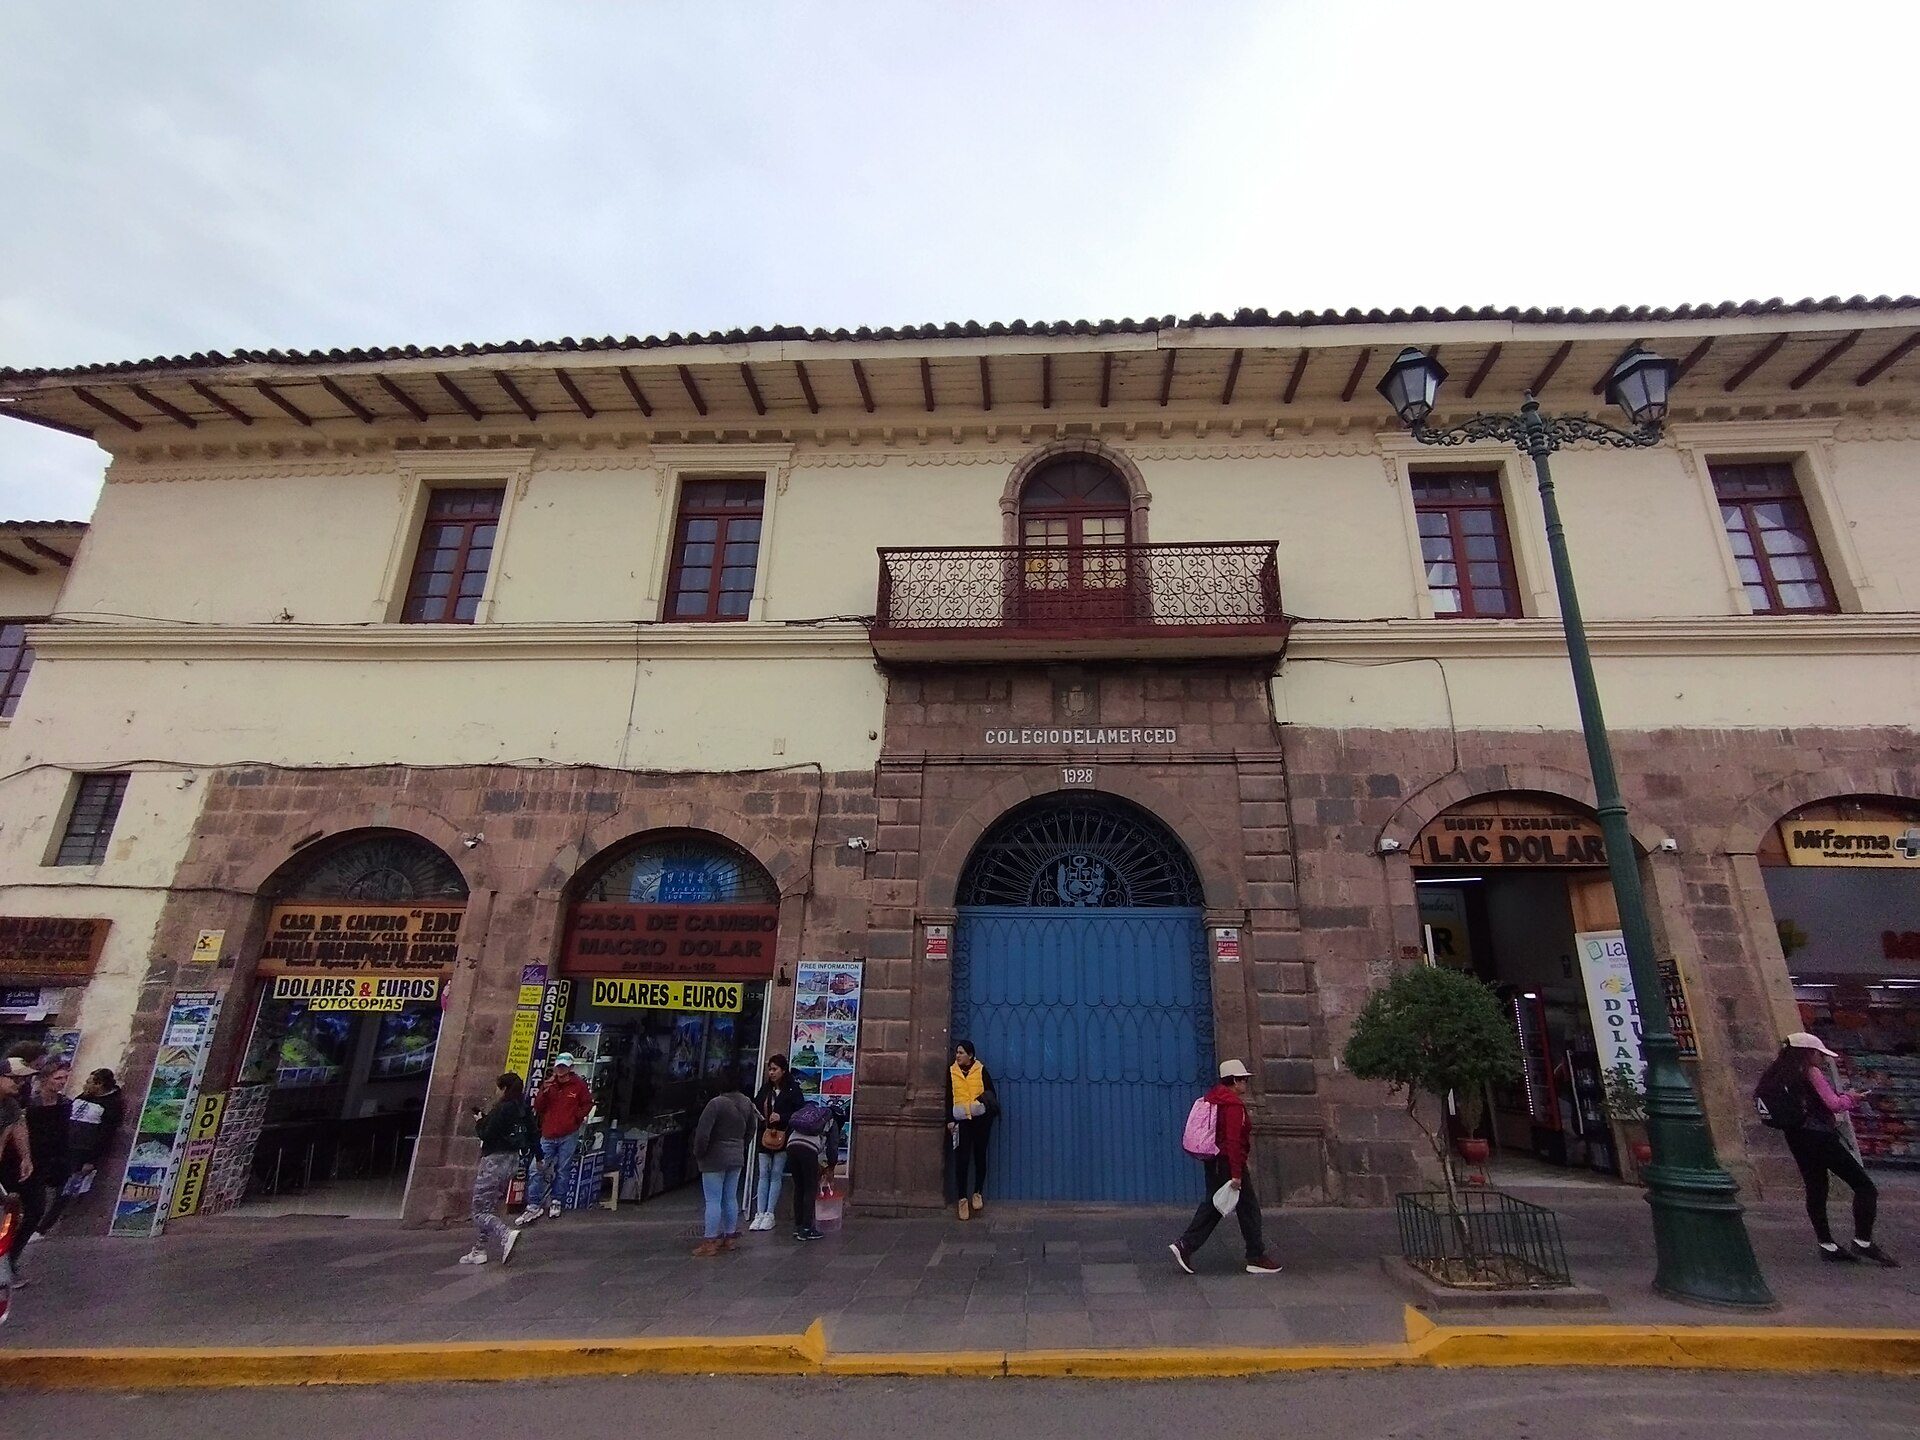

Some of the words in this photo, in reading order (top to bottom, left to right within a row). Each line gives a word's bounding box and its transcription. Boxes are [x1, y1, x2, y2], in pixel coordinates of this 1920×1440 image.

[1062, 768, 1093, 783] 1928
[1443, 818, 1494, 831] MONEY
[1502, 818, 1581, 831] EXCHANGE
[1793, 828, 1891, 850] Mifarma
[1427, 835, 1491, 862] LAC
[1500, 835, 1607, 863] DOLAR
[280, 913, 316, 931] CASA
[320, 915, 343, 931] DE
[346, 915, 408, 931] CAMBIO
[577, 913, 636, 931] CASA
[646, 914, 679, 931] DE
[685, 914, 776, 932] CAMBIO
[411, 932, 457, 943] CENTER
[578, 938, 667, 956] MACRO
[678, 939, 762, 957] DOLAR
[1605, 942, 1627, 957] La
[800, 962, 816, 970] FREE
[276, 978, 355, 997] DOLARES
[359, 981, 372, 997] &
[376, 978, 436, 998] EUROS
[595, 981, 669, 1005] DOLARES
[682, 985, 738, 1009] EUROS
[308, 998, 403, 1009] FOTOCOPIAS
[543, 986, 558, 1022] AROS
[538, 1031, 550, 1050] DE
[177, 1097, 218, 1214] DORES
